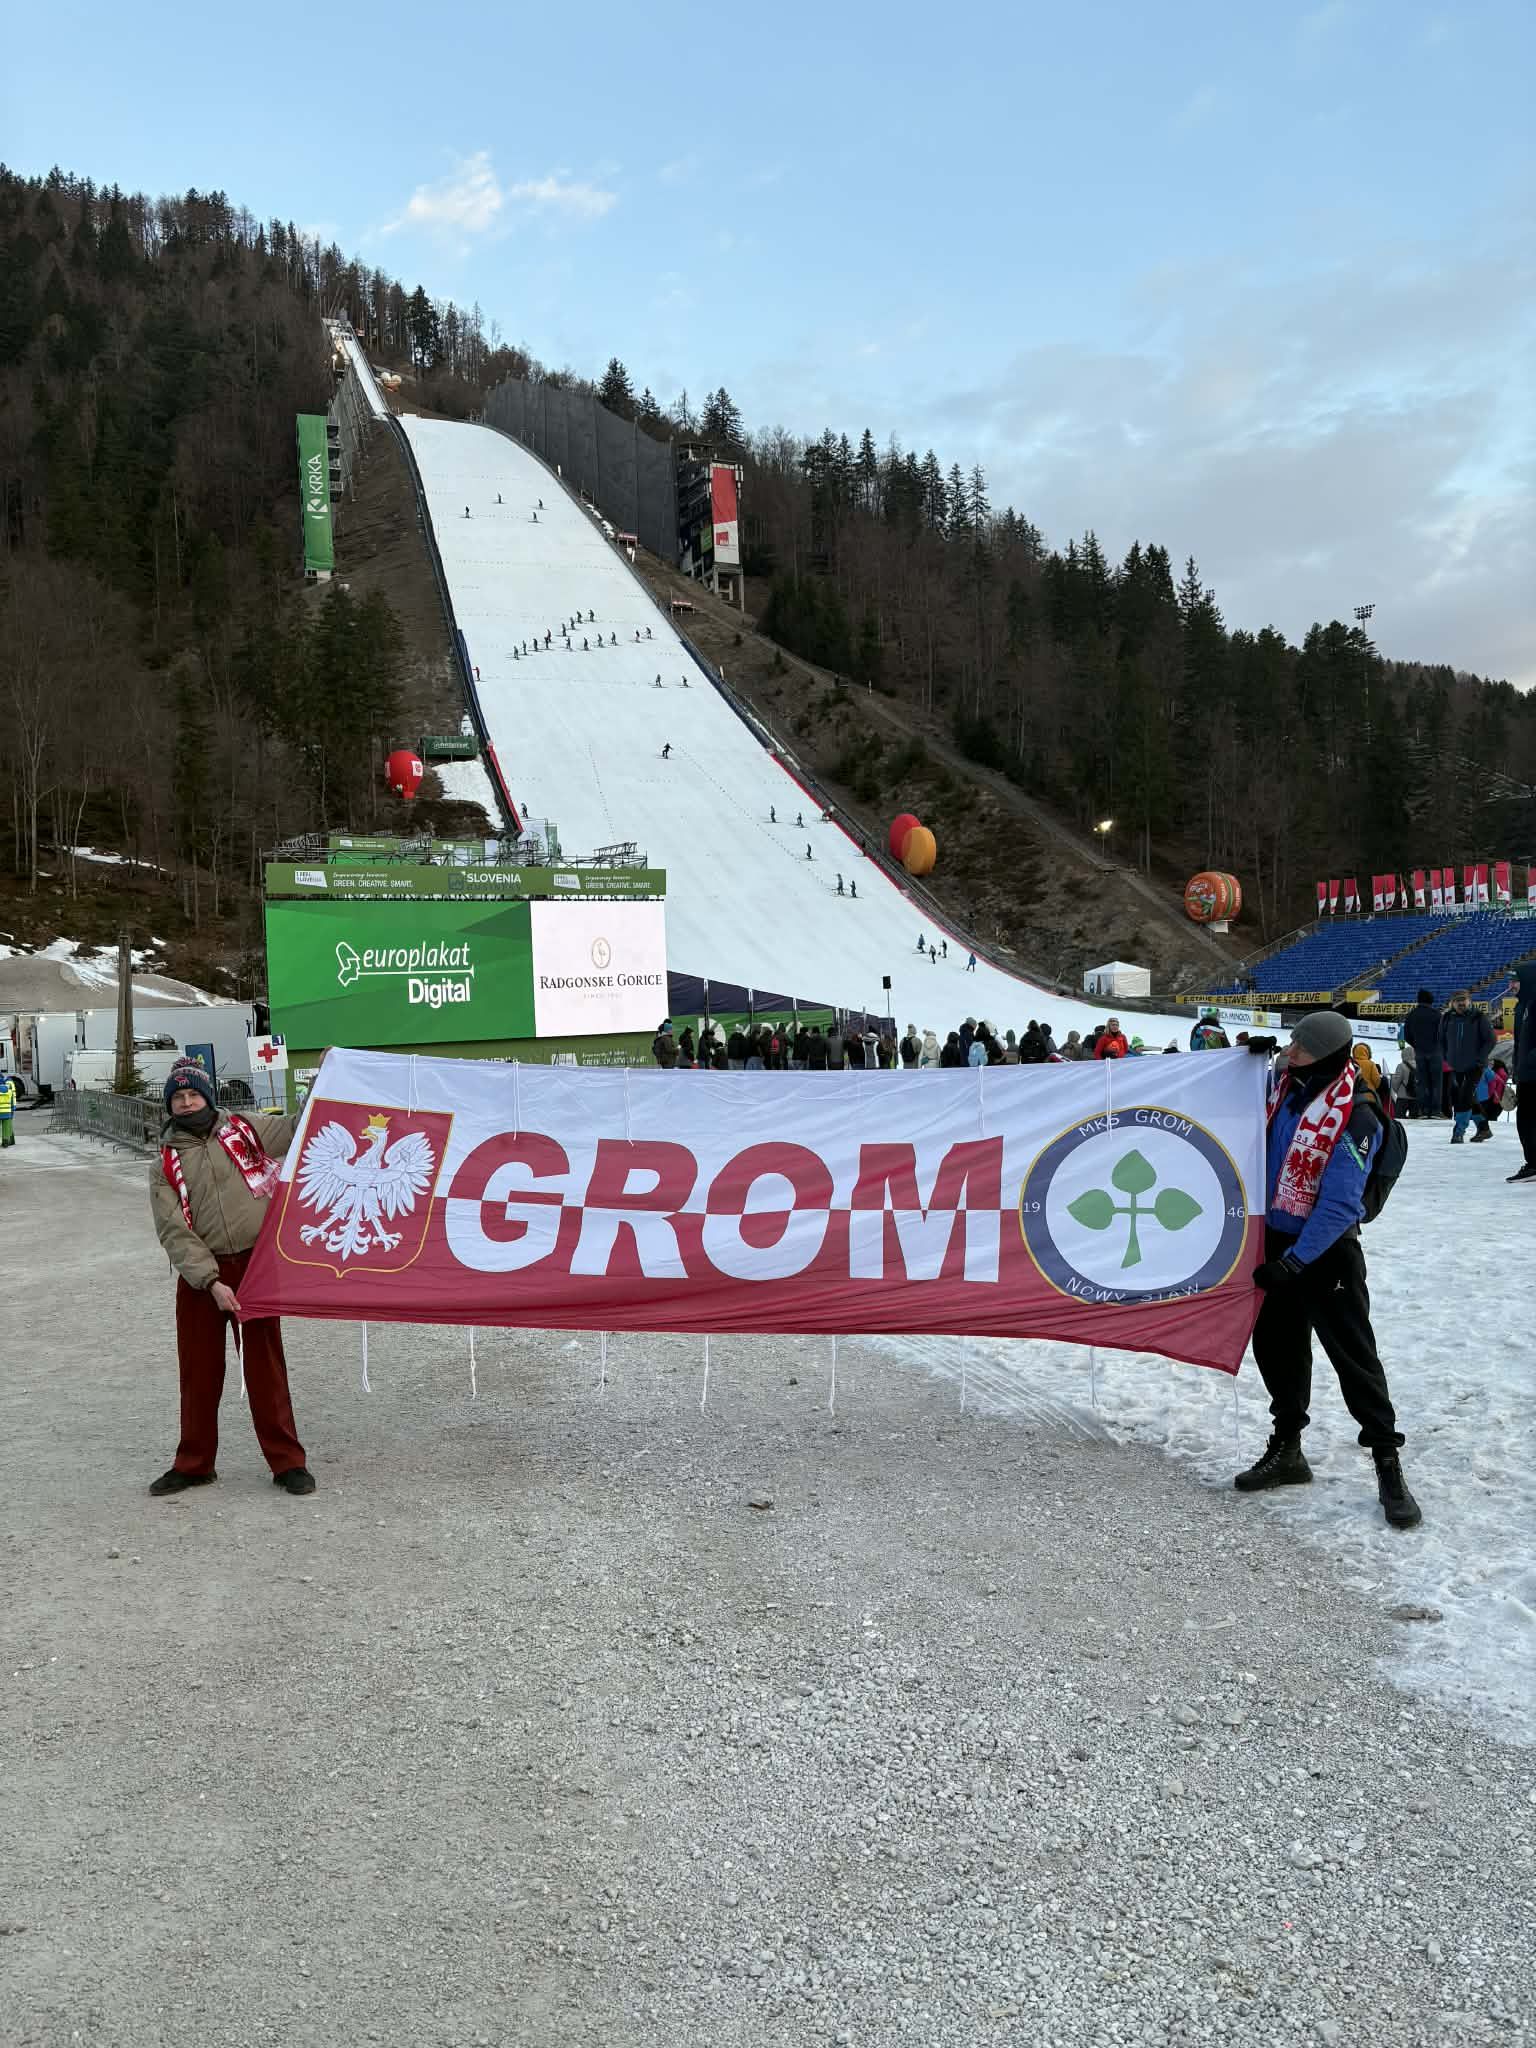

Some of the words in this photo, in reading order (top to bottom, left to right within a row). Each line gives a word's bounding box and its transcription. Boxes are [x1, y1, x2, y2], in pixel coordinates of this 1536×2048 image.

[307, 453, 322, 495] KRKA
[466, 873, 522, 883] SLOVENIA
[363, 940, 470, 972] europlakat
[408, 977, 471, 1008] Digital
[540, 975, 614, 989] RADGONSKE
[617, 973, 663, 987] GORICE
[1079, 1113, 1120, 1137] MKS
[1135, 1109, 1193, 1136] GROM
[445, 1131, 1003, 1283] GROM
[1023, 1202, 1040, 1213] 19
[1227, 1207, 1245, 1218] 46
